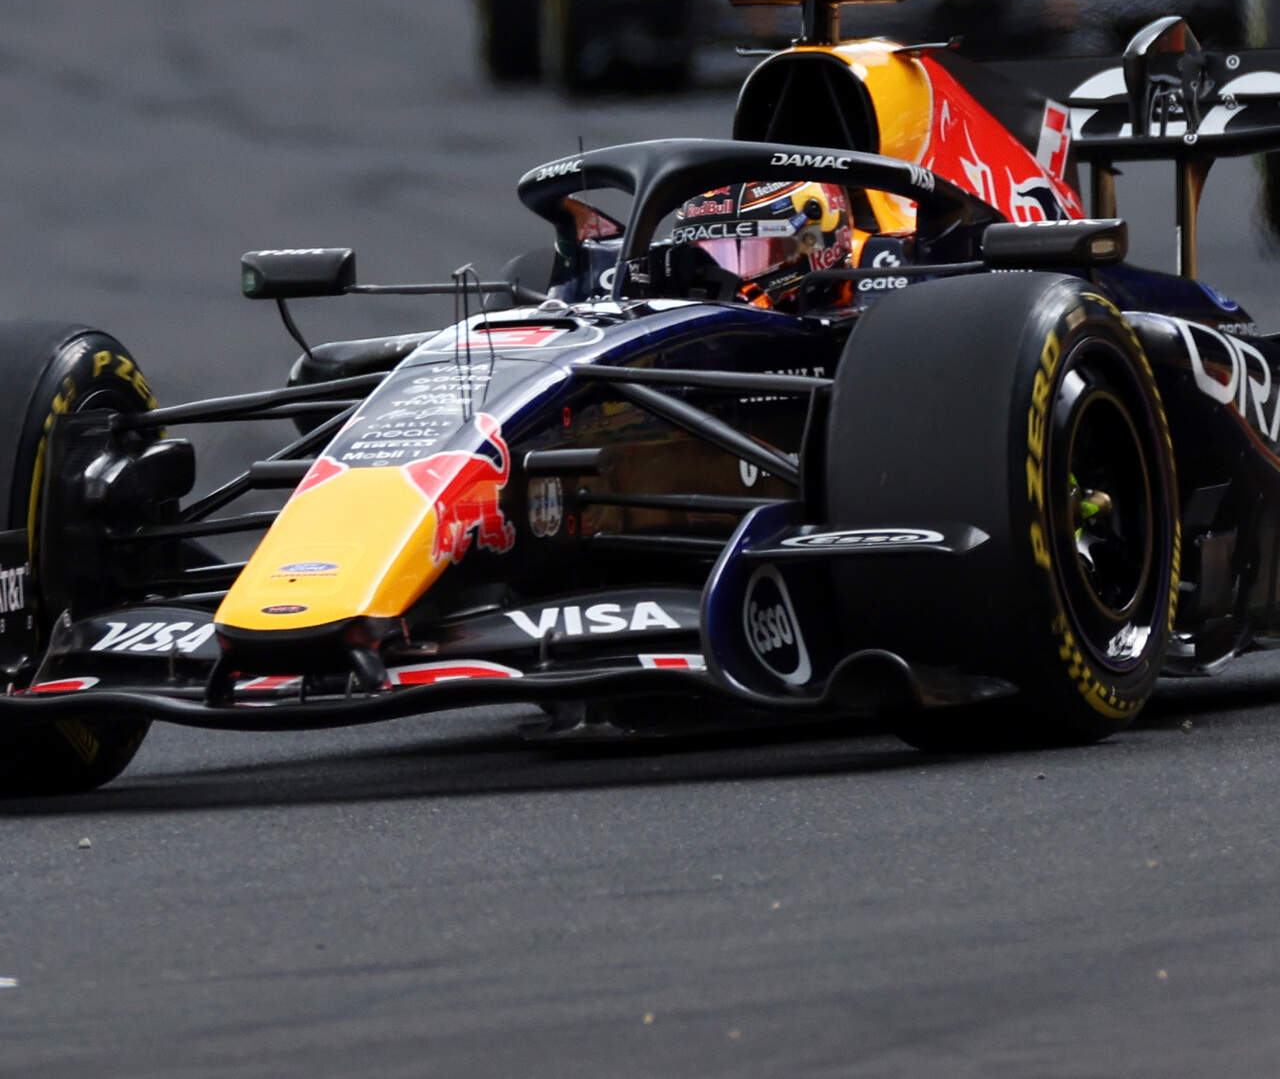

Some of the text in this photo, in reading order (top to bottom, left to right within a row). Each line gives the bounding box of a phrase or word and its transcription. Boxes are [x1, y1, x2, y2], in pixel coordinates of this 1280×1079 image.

[536, 159, 584, 182] DAMAC
[770, 153, 852, 170] DAMAC
[905, 163, 935, 193] VISA
[671, 222, 753, 244] ORACLE
[858, 276, 908, 291] Gate
[91, 350, 113, 378] P
[1025, 327, 1061, 513] ZERO
[342, 450, 405, 461] Mobil
[503, 600, 681, 639] VISA
[90, 621, 216, 653] VISA
